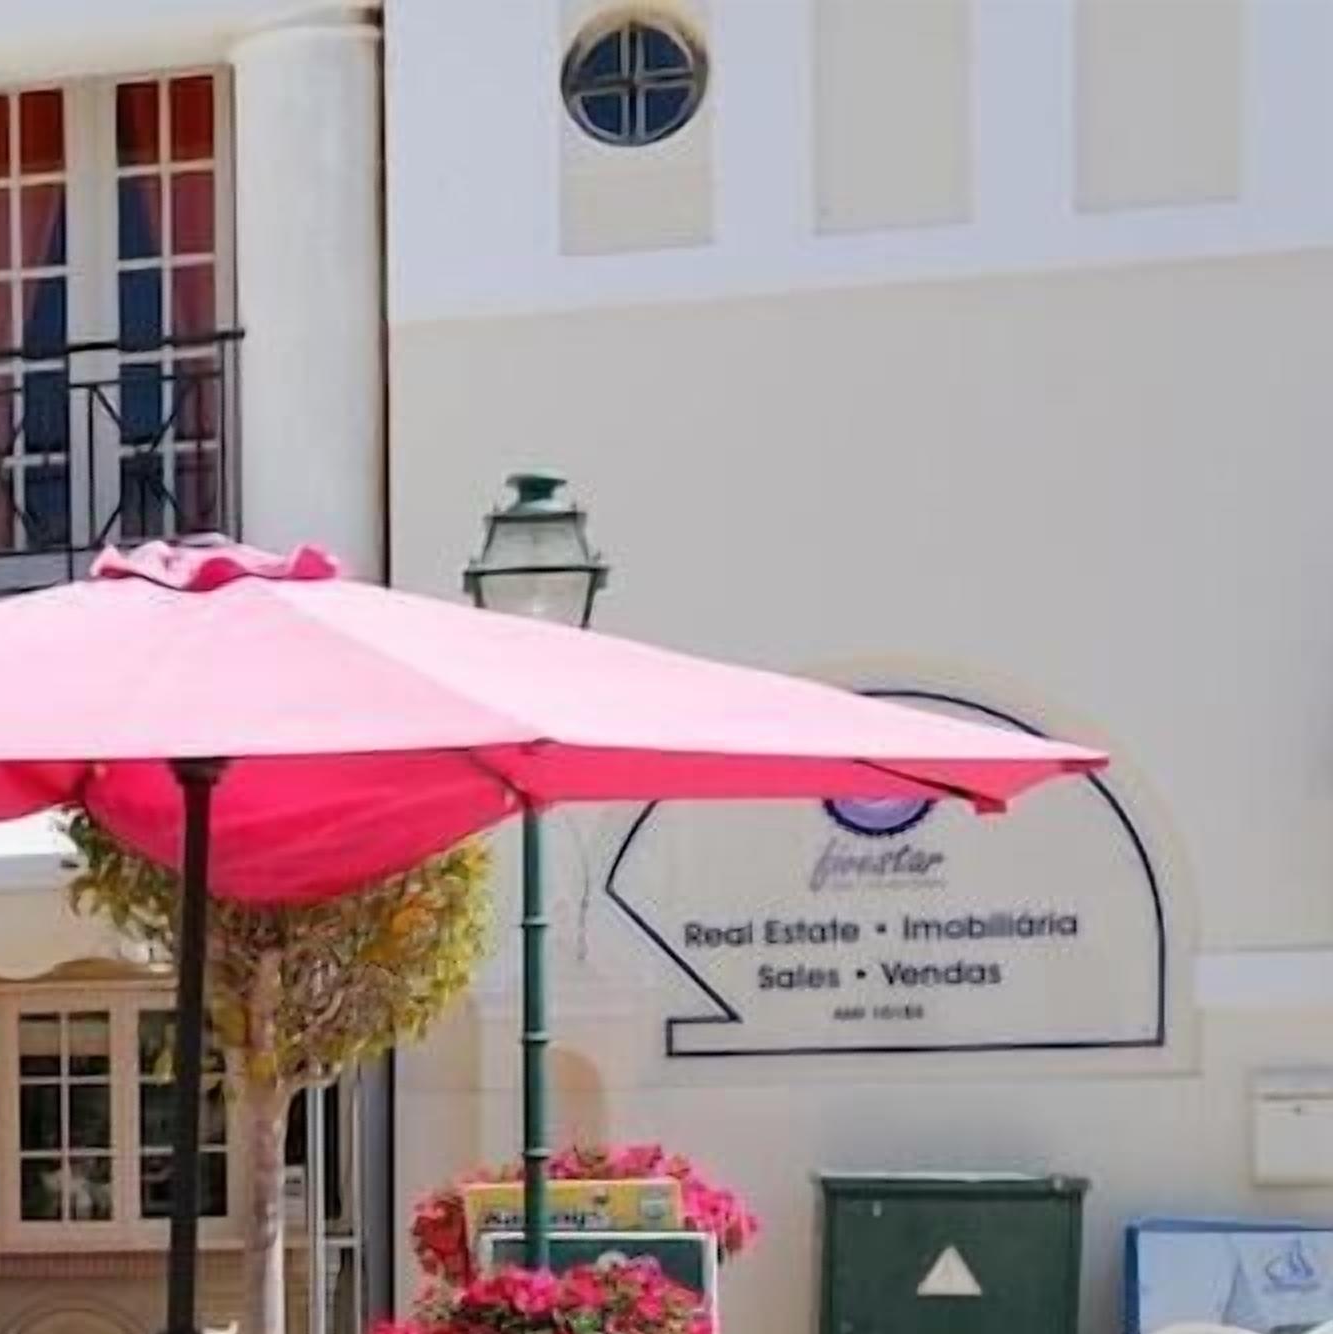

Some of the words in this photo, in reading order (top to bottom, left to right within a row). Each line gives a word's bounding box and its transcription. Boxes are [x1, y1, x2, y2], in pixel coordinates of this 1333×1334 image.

[684, 920, 753, 949] Real
[764, 917, 861, 945] Estate
[757, 963, 841, 990] Sales
[881, 960, 1001, 987] Vendas
